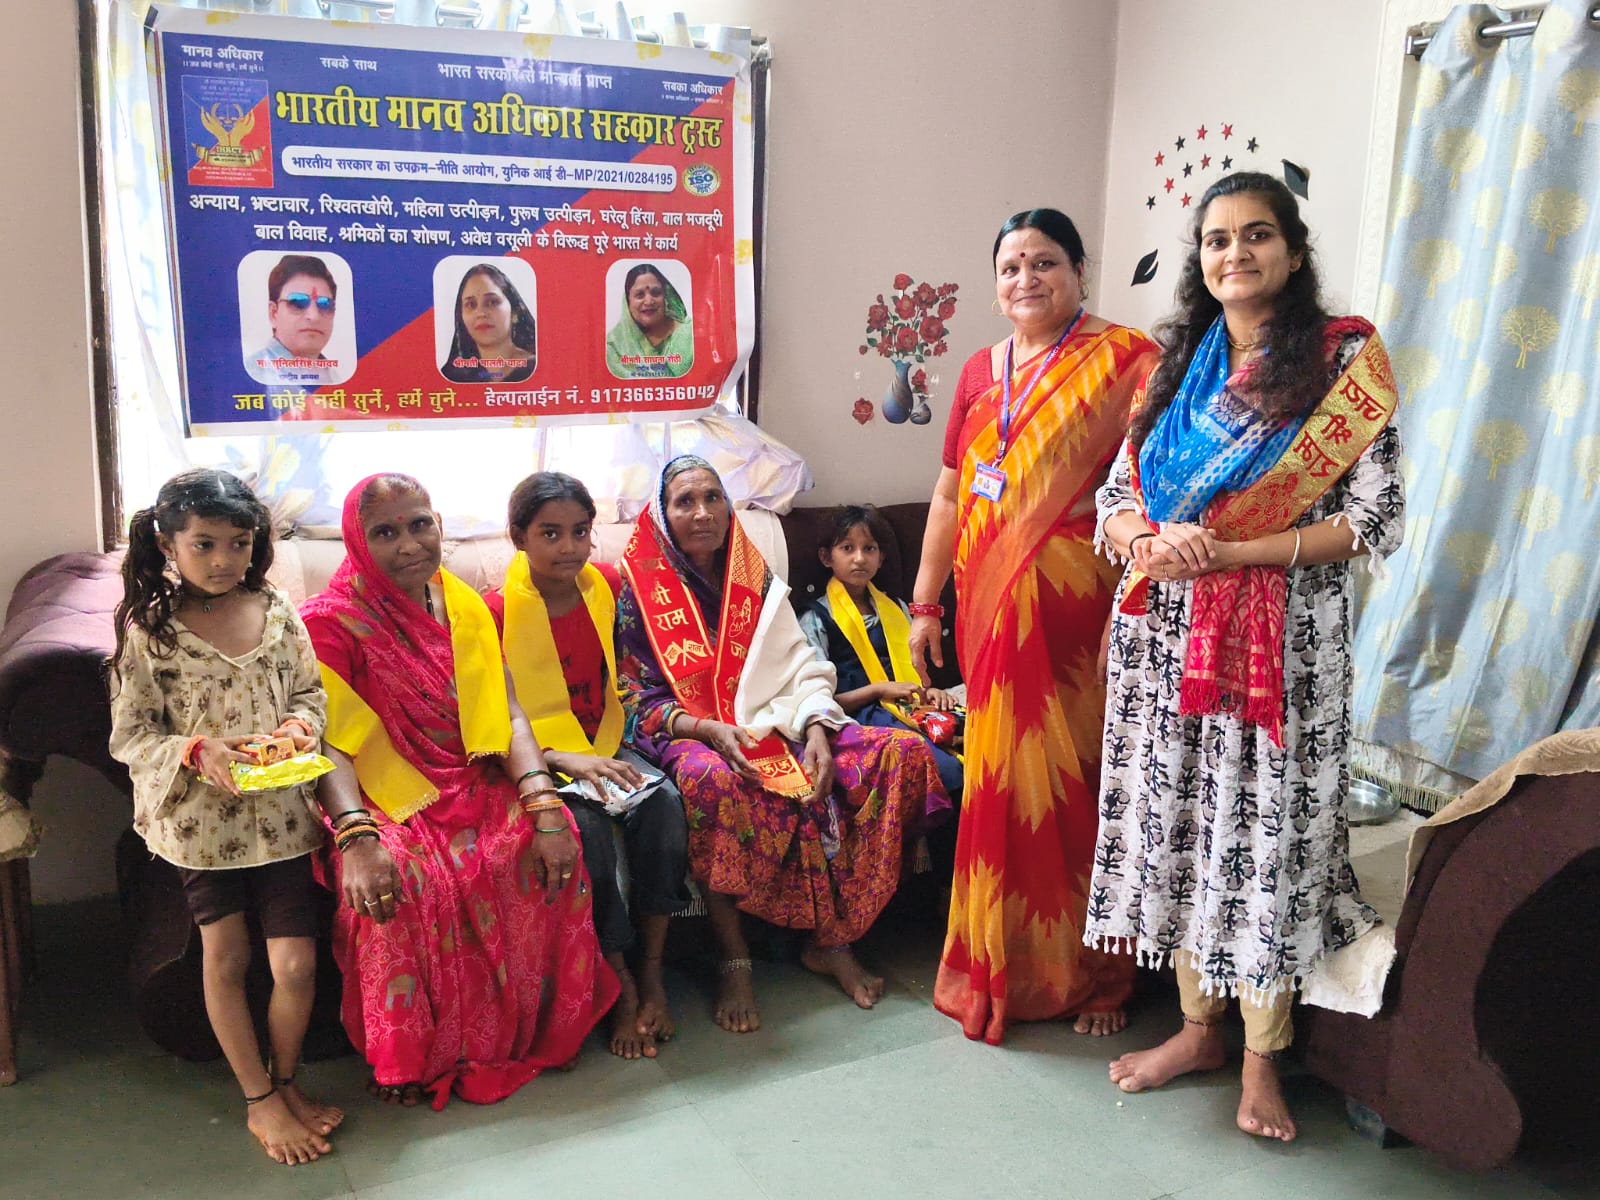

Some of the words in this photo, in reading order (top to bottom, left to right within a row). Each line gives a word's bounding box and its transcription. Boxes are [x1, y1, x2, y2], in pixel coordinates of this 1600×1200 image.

[181, 44, 213, 58] मानव
[217, 45, 264, 61] अधिकार
[319, 55, 349, 70] सबके
[352, 59, 377, 71] साथ
[438, 63, 471, 79] भारत
[476, 66, 519, 82] सरकार
[523, 66, 535, 83] से
[586, 74, 613, 89] प्राप्त
[662, 81, 687, 93] सबका
[690, 81, 723, 96] अधिकार
[275, 85, 380, 128] भारतीय
[385, 96, 467, 133] मानव
[472, 93, 586, 140] अधिकार
[589, 109, 676, 146] सहकार
[680, 115, 723, 154] ट्रस्ट
[292, 154, 332, 169] भारतीय
[335, 159, 373, 171] सरकार
[376, 160, 390, 172] का
[462, 162, 498, 178] आयोग,
[501, 163, 530, 182] युनिक
[533, 165, 552, 181] आई
[688, 173, 714, 185] ISO
[189, 194, 246, 213] अन्याय,
[250, 195, 315, 215] भ्रष्टाचार,
[318, 193, 399, 218] रिश्वतखोरी,
[402, 197, 444, 218] महिला
[448, 199, 505, 222] उत्पीड़न,
[543, 202, 595, 225] उत्पीड़न,
[599, 205, 629, 229] घरेलू
[630, 206, 659, 226] हिंसा,
[662, 212, 683, 226] बाल
[685, 209, 723, 231] मजदूरी
[254, 224, 284, 240] बाल
[288, 220, 333, 243] विवाह,
[338, 222, 385, 243] श्रमिकों
[388, 229, 408, 243] का
[411, 224, 456, 247] शोषण,
[495, 228, 532, 252] वसूली
[535, 229, 549, 248] के
[593, 231, 609, 254] पूरे
[612, 235, 641, 250] भारत
[643, 232, 653, 250] में
[655, 232, 678, 251] कार्य
[232, 394, 266, 410] जब
[270, 389, 307, 411] कोई
[397, 388, 422, 408] हमें
[484, 386, 560, 407] हेल्पलाईन
[565, 387, 584, 405] नं.
[590, 385, 716, 404] 917366356042
[653, 608, 689, 631] राम
